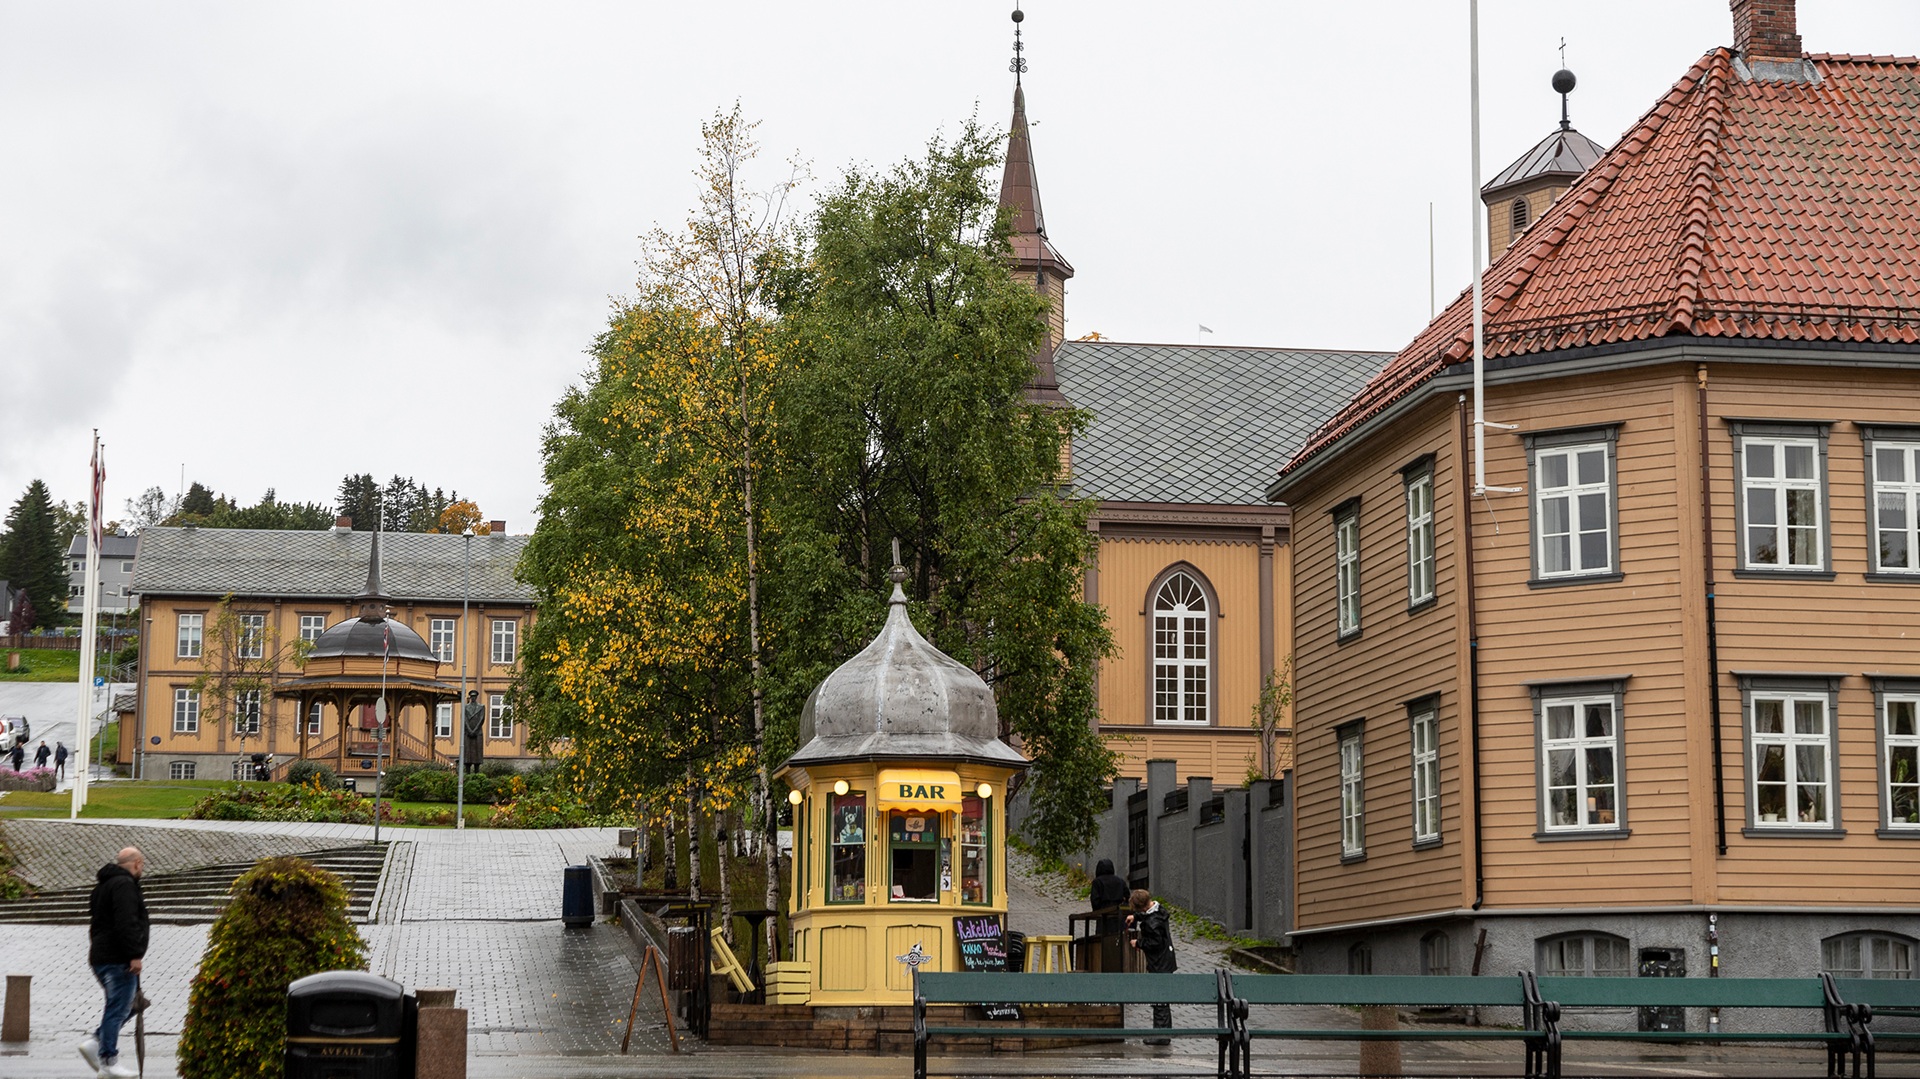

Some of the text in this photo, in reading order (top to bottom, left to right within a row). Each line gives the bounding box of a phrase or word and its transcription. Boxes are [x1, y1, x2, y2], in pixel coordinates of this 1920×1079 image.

[899, 784, 945, 799] BAR
[962, 943, 982, 954] KAKAO
[322, 1047, 363, 1056] AVFALL
